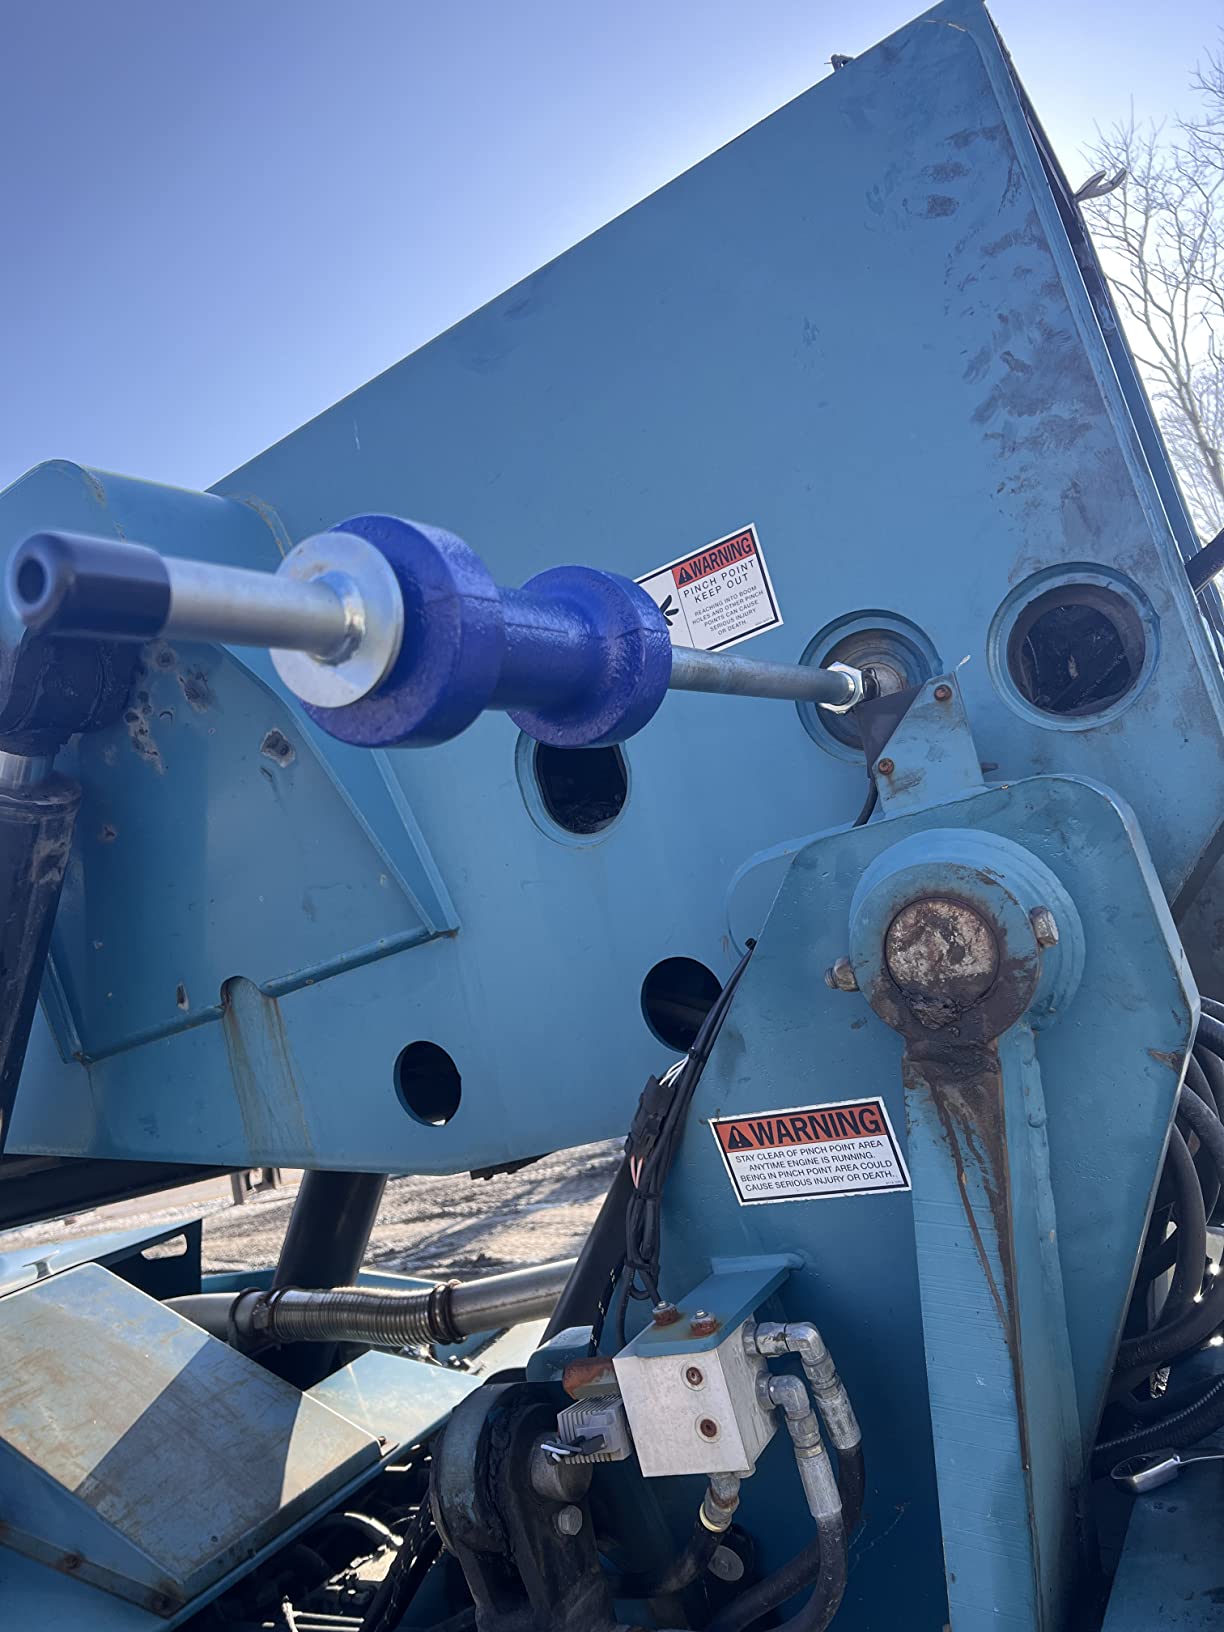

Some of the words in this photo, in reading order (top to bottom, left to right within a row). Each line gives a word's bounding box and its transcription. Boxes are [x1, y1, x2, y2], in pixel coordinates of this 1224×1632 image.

[689, 537, 752, 577] WARNING
[684, 578, 716, 597] PINCH
[722, 560, 754, 581] POINT
[695, 586, 722, 603] KEEP
[727, 574, 748, 588] OUT
[692, 614, 711, 624] HOLES
[712, 609, 724, 618] AND
[725, 599, 744, 612] OTHER
[745, 590, 763, 602] PINCH
[695, 602, 722, 616] REACHING
[724, 594, 738, 605] INTO
[740, 586, 757, 596] BOOM
[704, 616, 725, 627] POINTS
[726, 609, 738, 618] CAN
[739, 600, 758, 612] CAUSE
[710, 617, 735, 631] SERIOUS
[736, 608, 756, 621] INJURY
[718, 627, 726, 635] OR
[749, 1108, 881, 1146] WARNING
[736, 1155, 755, 1163] STAY
[757, 1151, 785, 1161] CLEAR
[787, 1149, 798, 1157] OF
[800, 1146, 827, 1156] PINCH
[829, 1143, 856, 1152] POINT
[858, 1140, 883, 1148] AREA
[750, 1161, 785, 1172] ANYTIME
[788, 1157, 819, 1167] ENGINE
[821, 1155, 830, 1163] IS
[832, 1152, 875, 1162] RUNNING.
[741, 1173, 765, 1182] BEING
[768, 1171, 776, 1179] IN
[778, 1167, 805, 1178] PINCH
[807, 1165, 832, 1174] POINT
[835, 1162, 858, 1171] AREA
[860, 1160, 892, 1169] COULD
[746, 1181, 774, 1191] CAUSE
[775, 1178, 812, 1188] SERIOUS
[814, 1175, 845, 1185] INJURY
[863, 1171, 895, 1180] DEATH.
